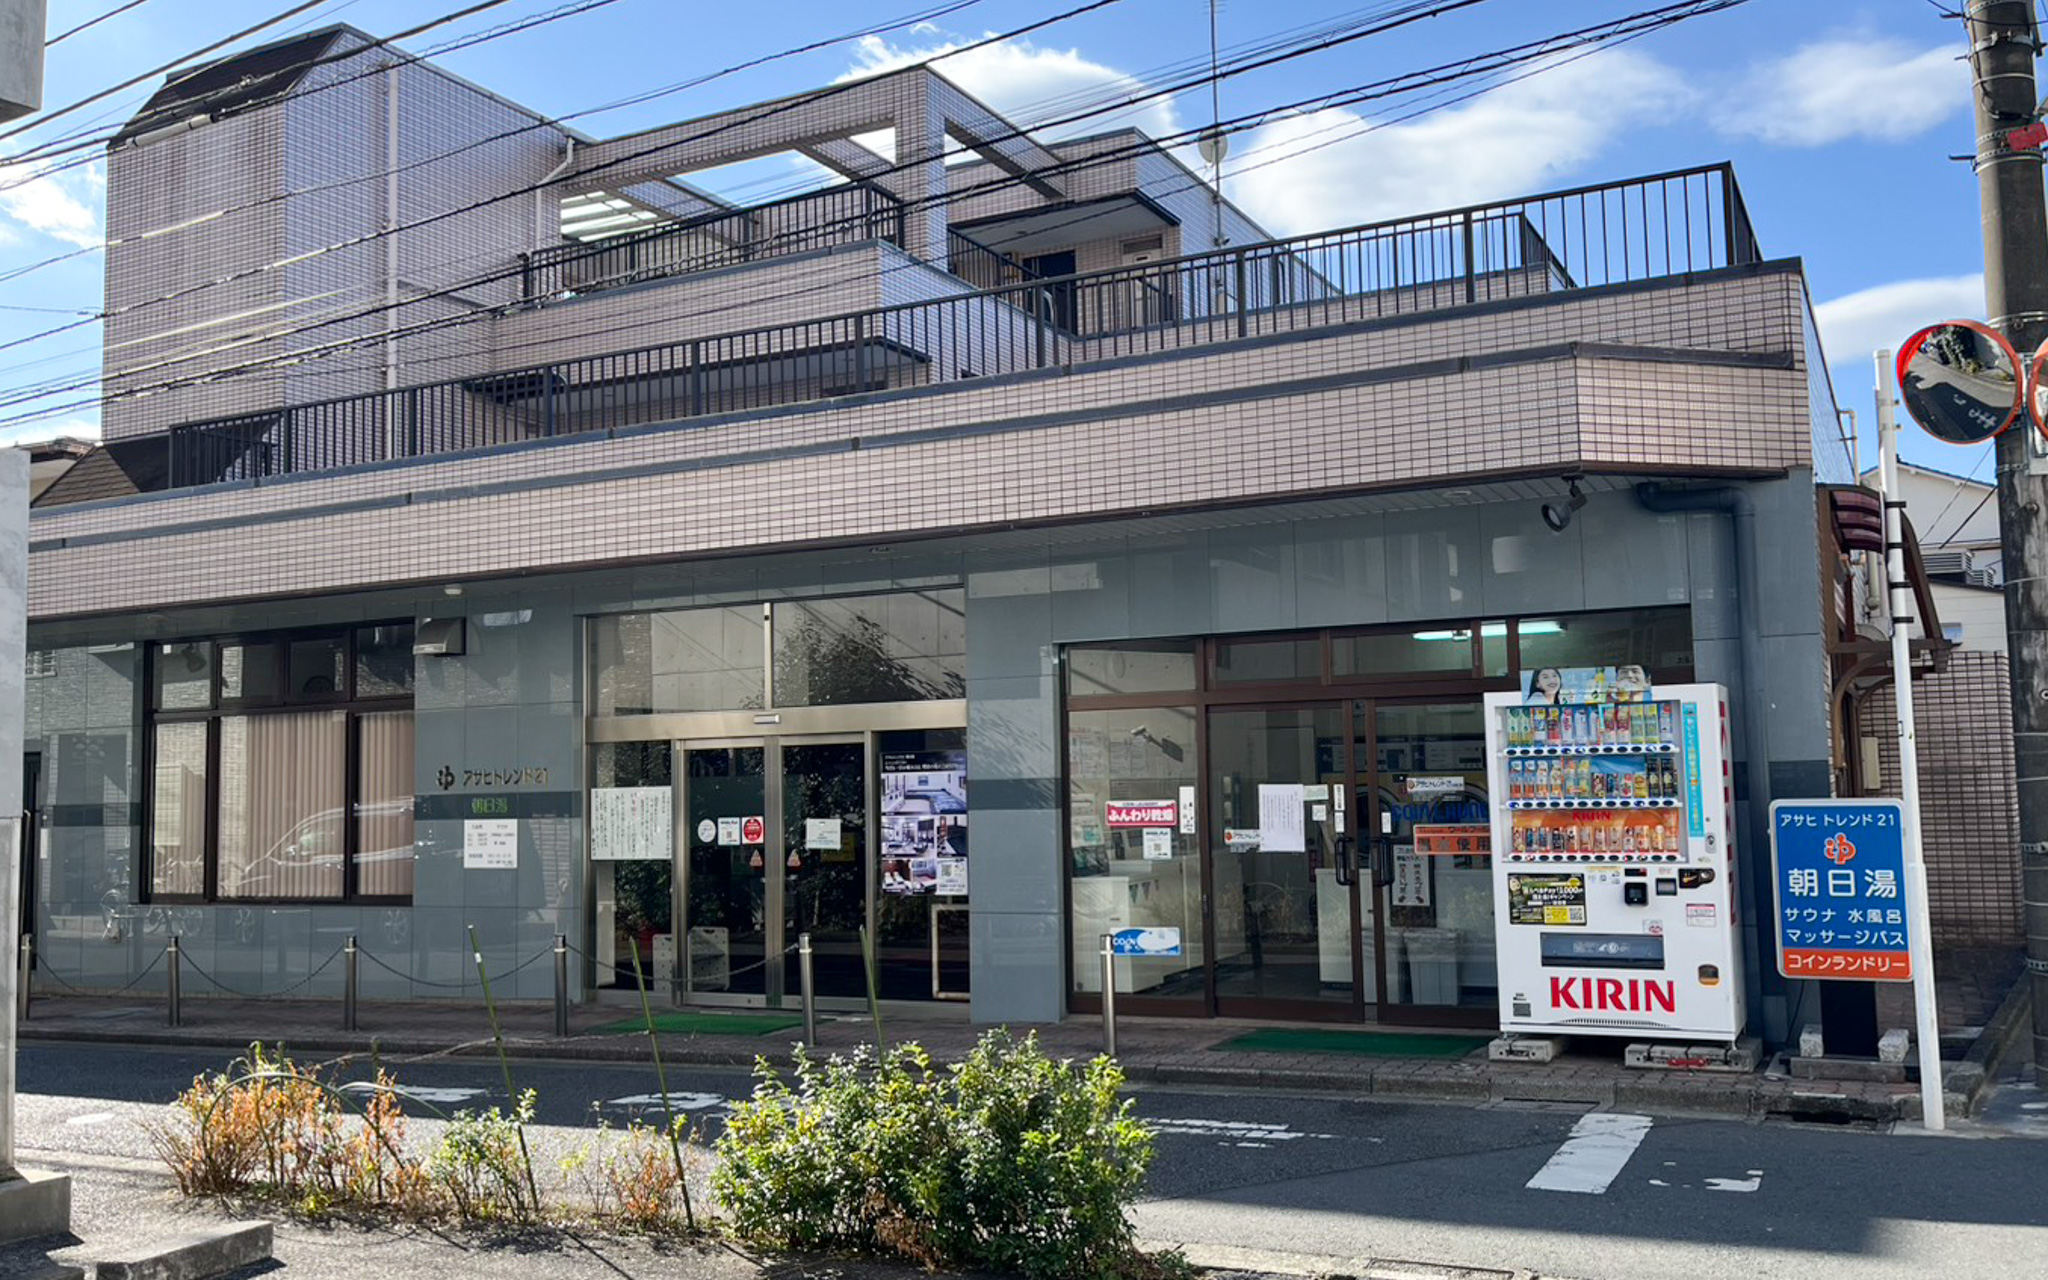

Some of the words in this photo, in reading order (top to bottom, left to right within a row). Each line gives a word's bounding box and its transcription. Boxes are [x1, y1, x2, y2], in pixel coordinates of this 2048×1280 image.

[463, 767, 549, 786] アサヒトレンド21
[1573, 810, 1611, 821] KIRIN
[1780, 813, 1817, 827] アサヒ
[1823, 813, 1873, 827] トレンド
[1877, 813, 1895, 827] 21
[1788, 868, 1898, 898] 朝日湯
[1784, 907, 1837, 923] サウナ
[1848, 908, 1902, 925] 水風呂
[1786, 929, 1905, 946] マッサージバス
[1788, 954, 1906, 973] コインランドリー
[1549, 976, 1676, 1013] KIRIN
